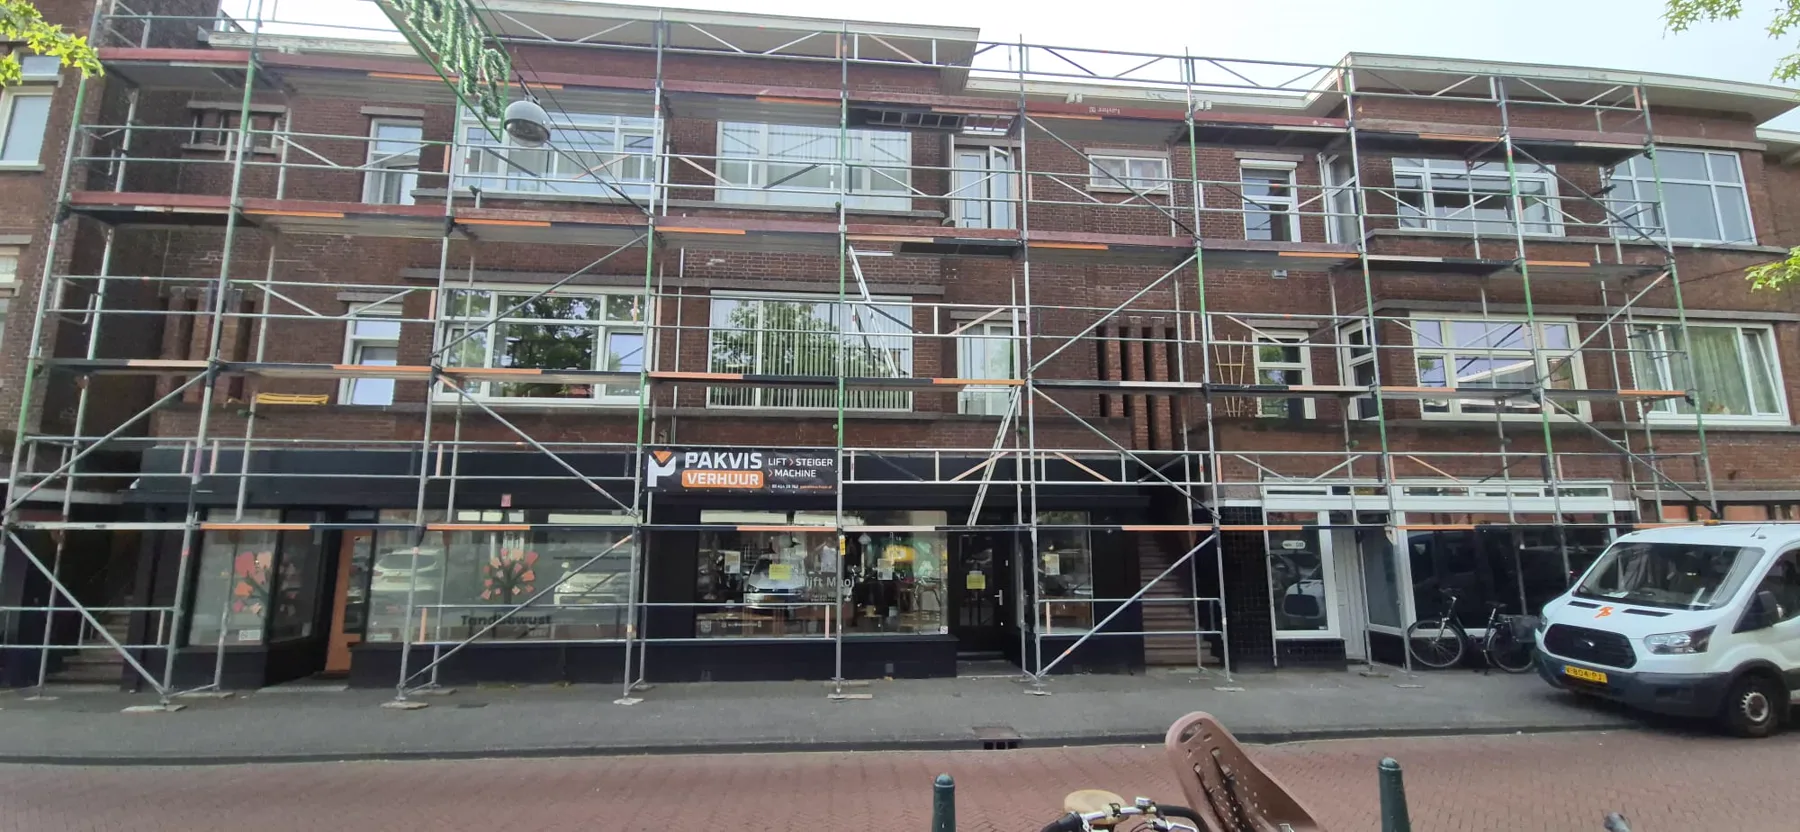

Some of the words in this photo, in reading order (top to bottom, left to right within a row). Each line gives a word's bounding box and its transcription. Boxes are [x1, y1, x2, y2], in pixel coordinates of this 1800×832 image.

[684, 451, 763, 469] PAKVIS
[768, 457, 787, 466] LIFT
[795, 458, 834, 467] STEIGER
[686, 472, 760, 486] VERHUUR
[774, 468, 817, 478] MACHINE
